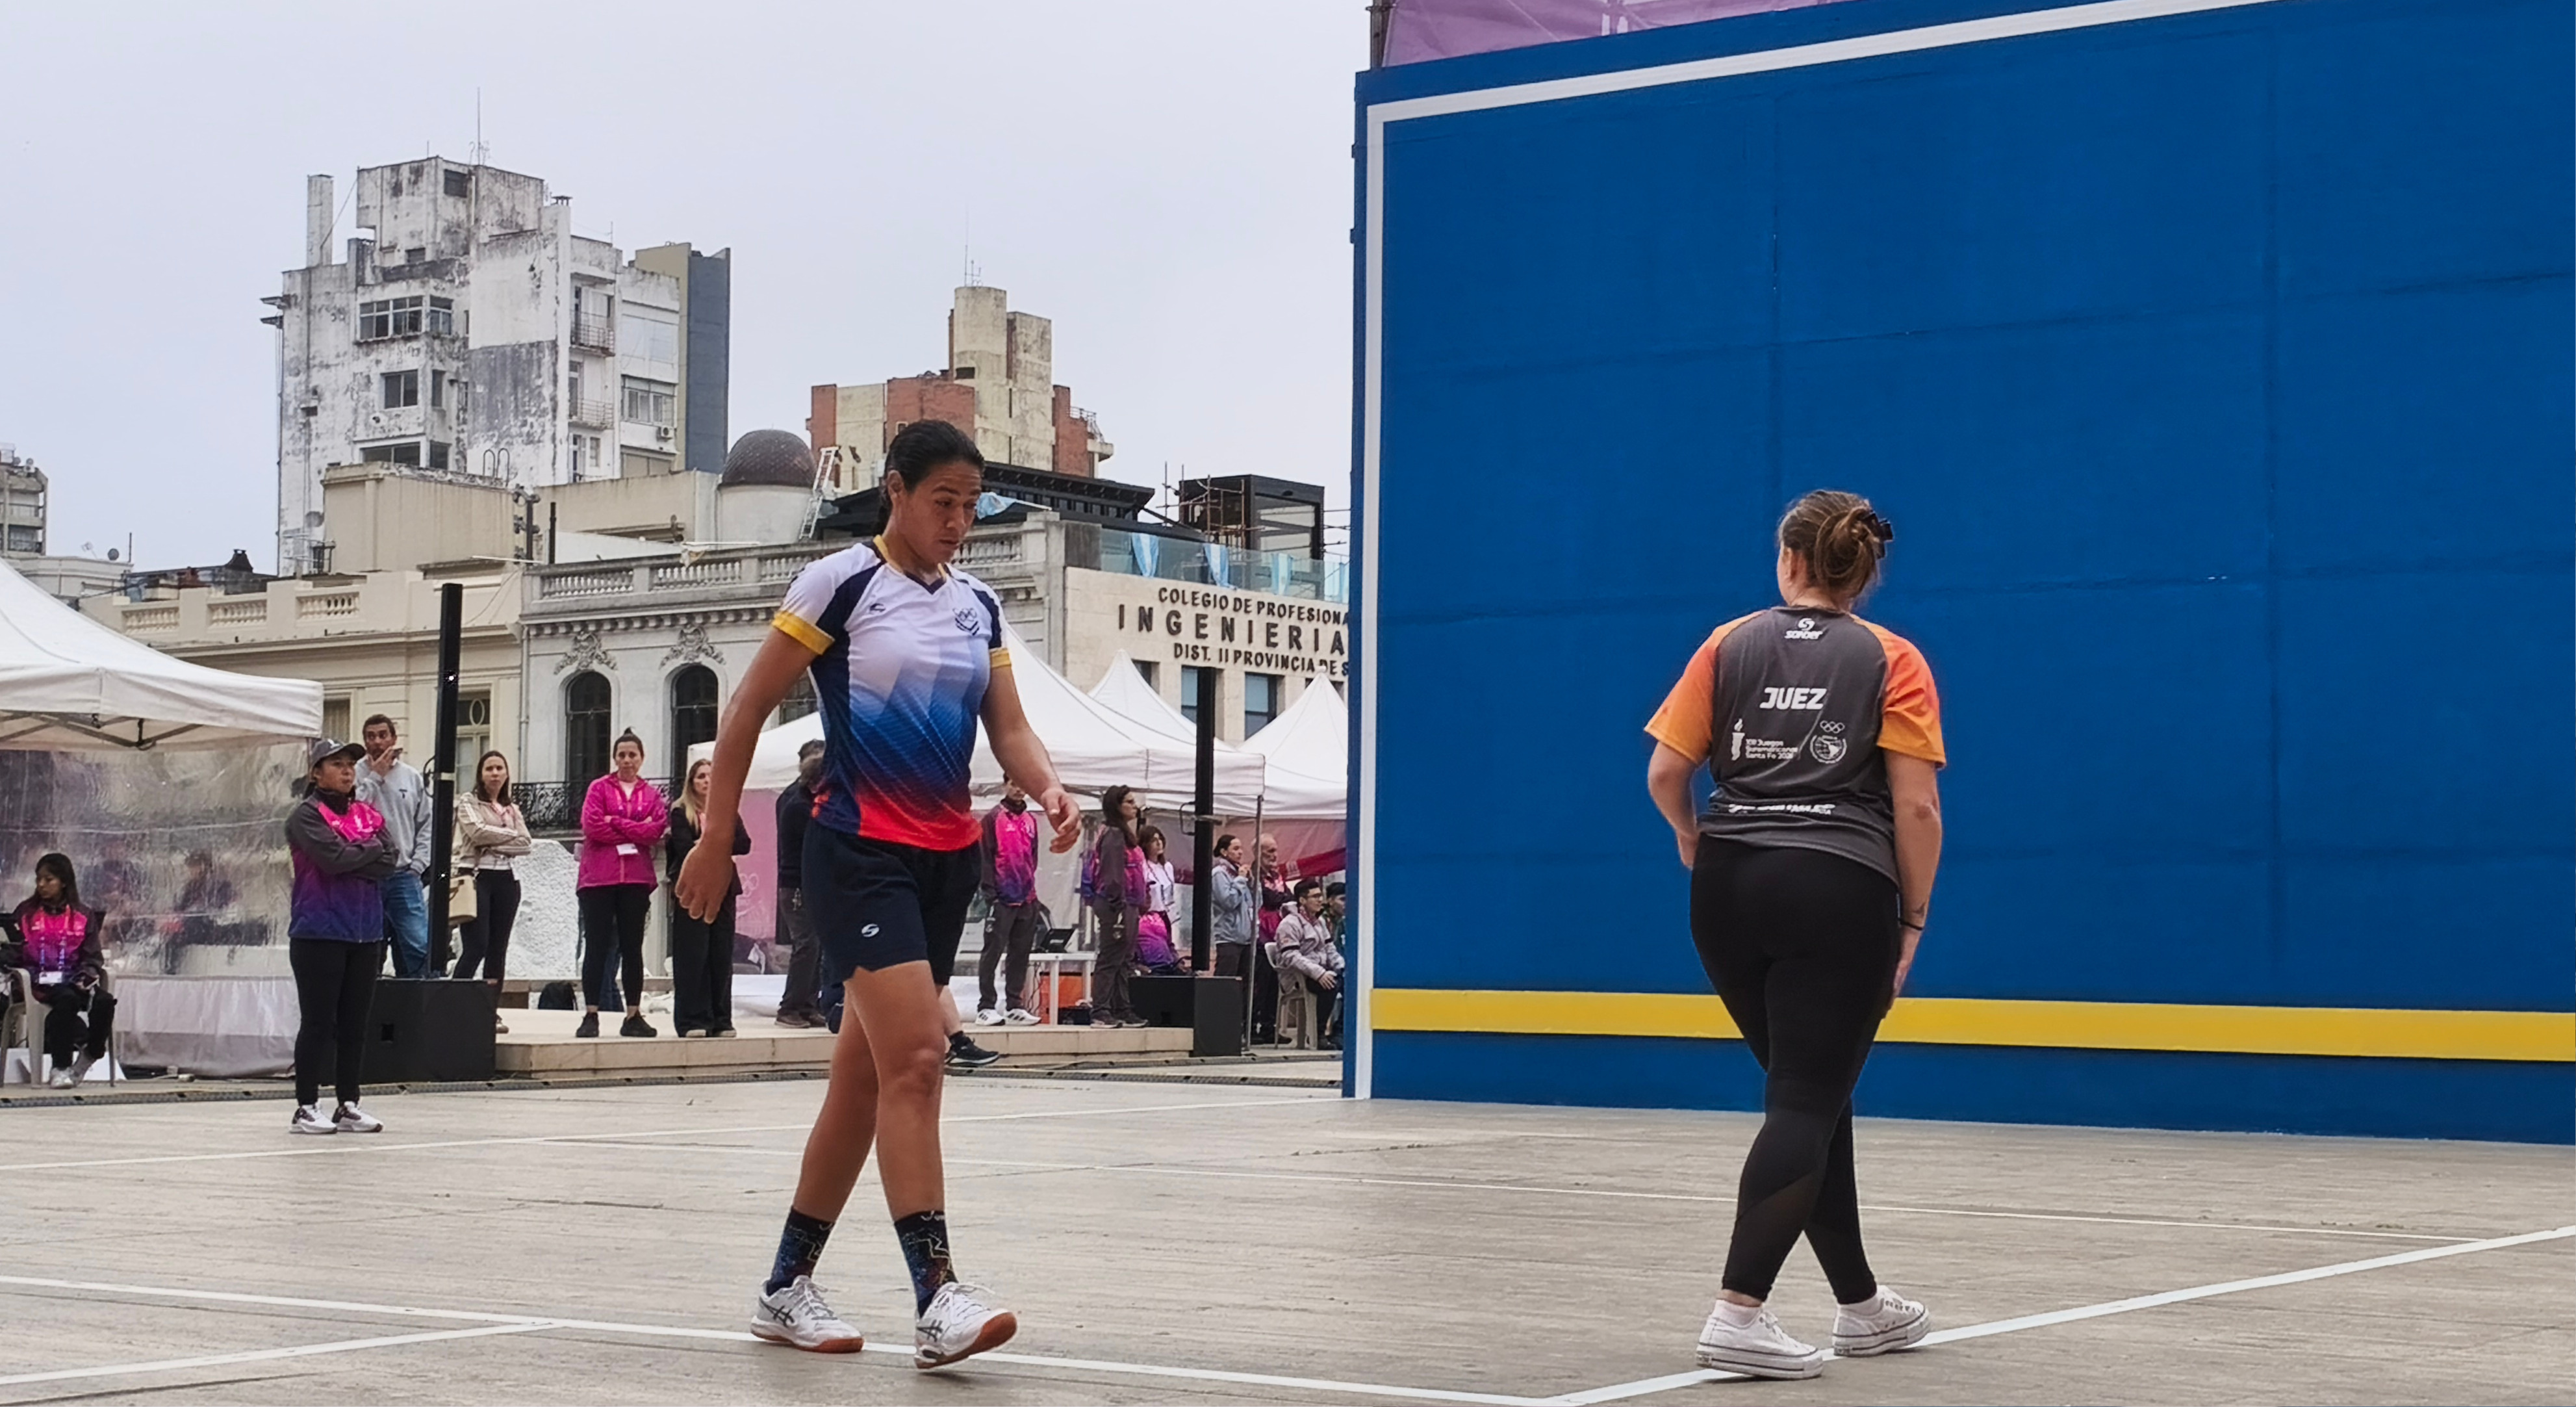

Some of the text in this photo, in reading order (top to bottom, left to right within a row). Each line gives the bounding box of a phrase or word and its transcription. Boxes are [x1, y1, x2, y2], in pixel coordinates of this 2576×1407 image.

[1158, 587, 1229, 610] COLEGIO
[1233, 597, 1252, 614] DE
[1119, 604, 1345, 656] INGENIERIA
[1173, 642, 1211, 661] DIST.
[1219, 647, 1229, 663] II
[1233, 650, 1315, 673] PROVINCIA
[1759, 687, 1828, 710] JUEZ
